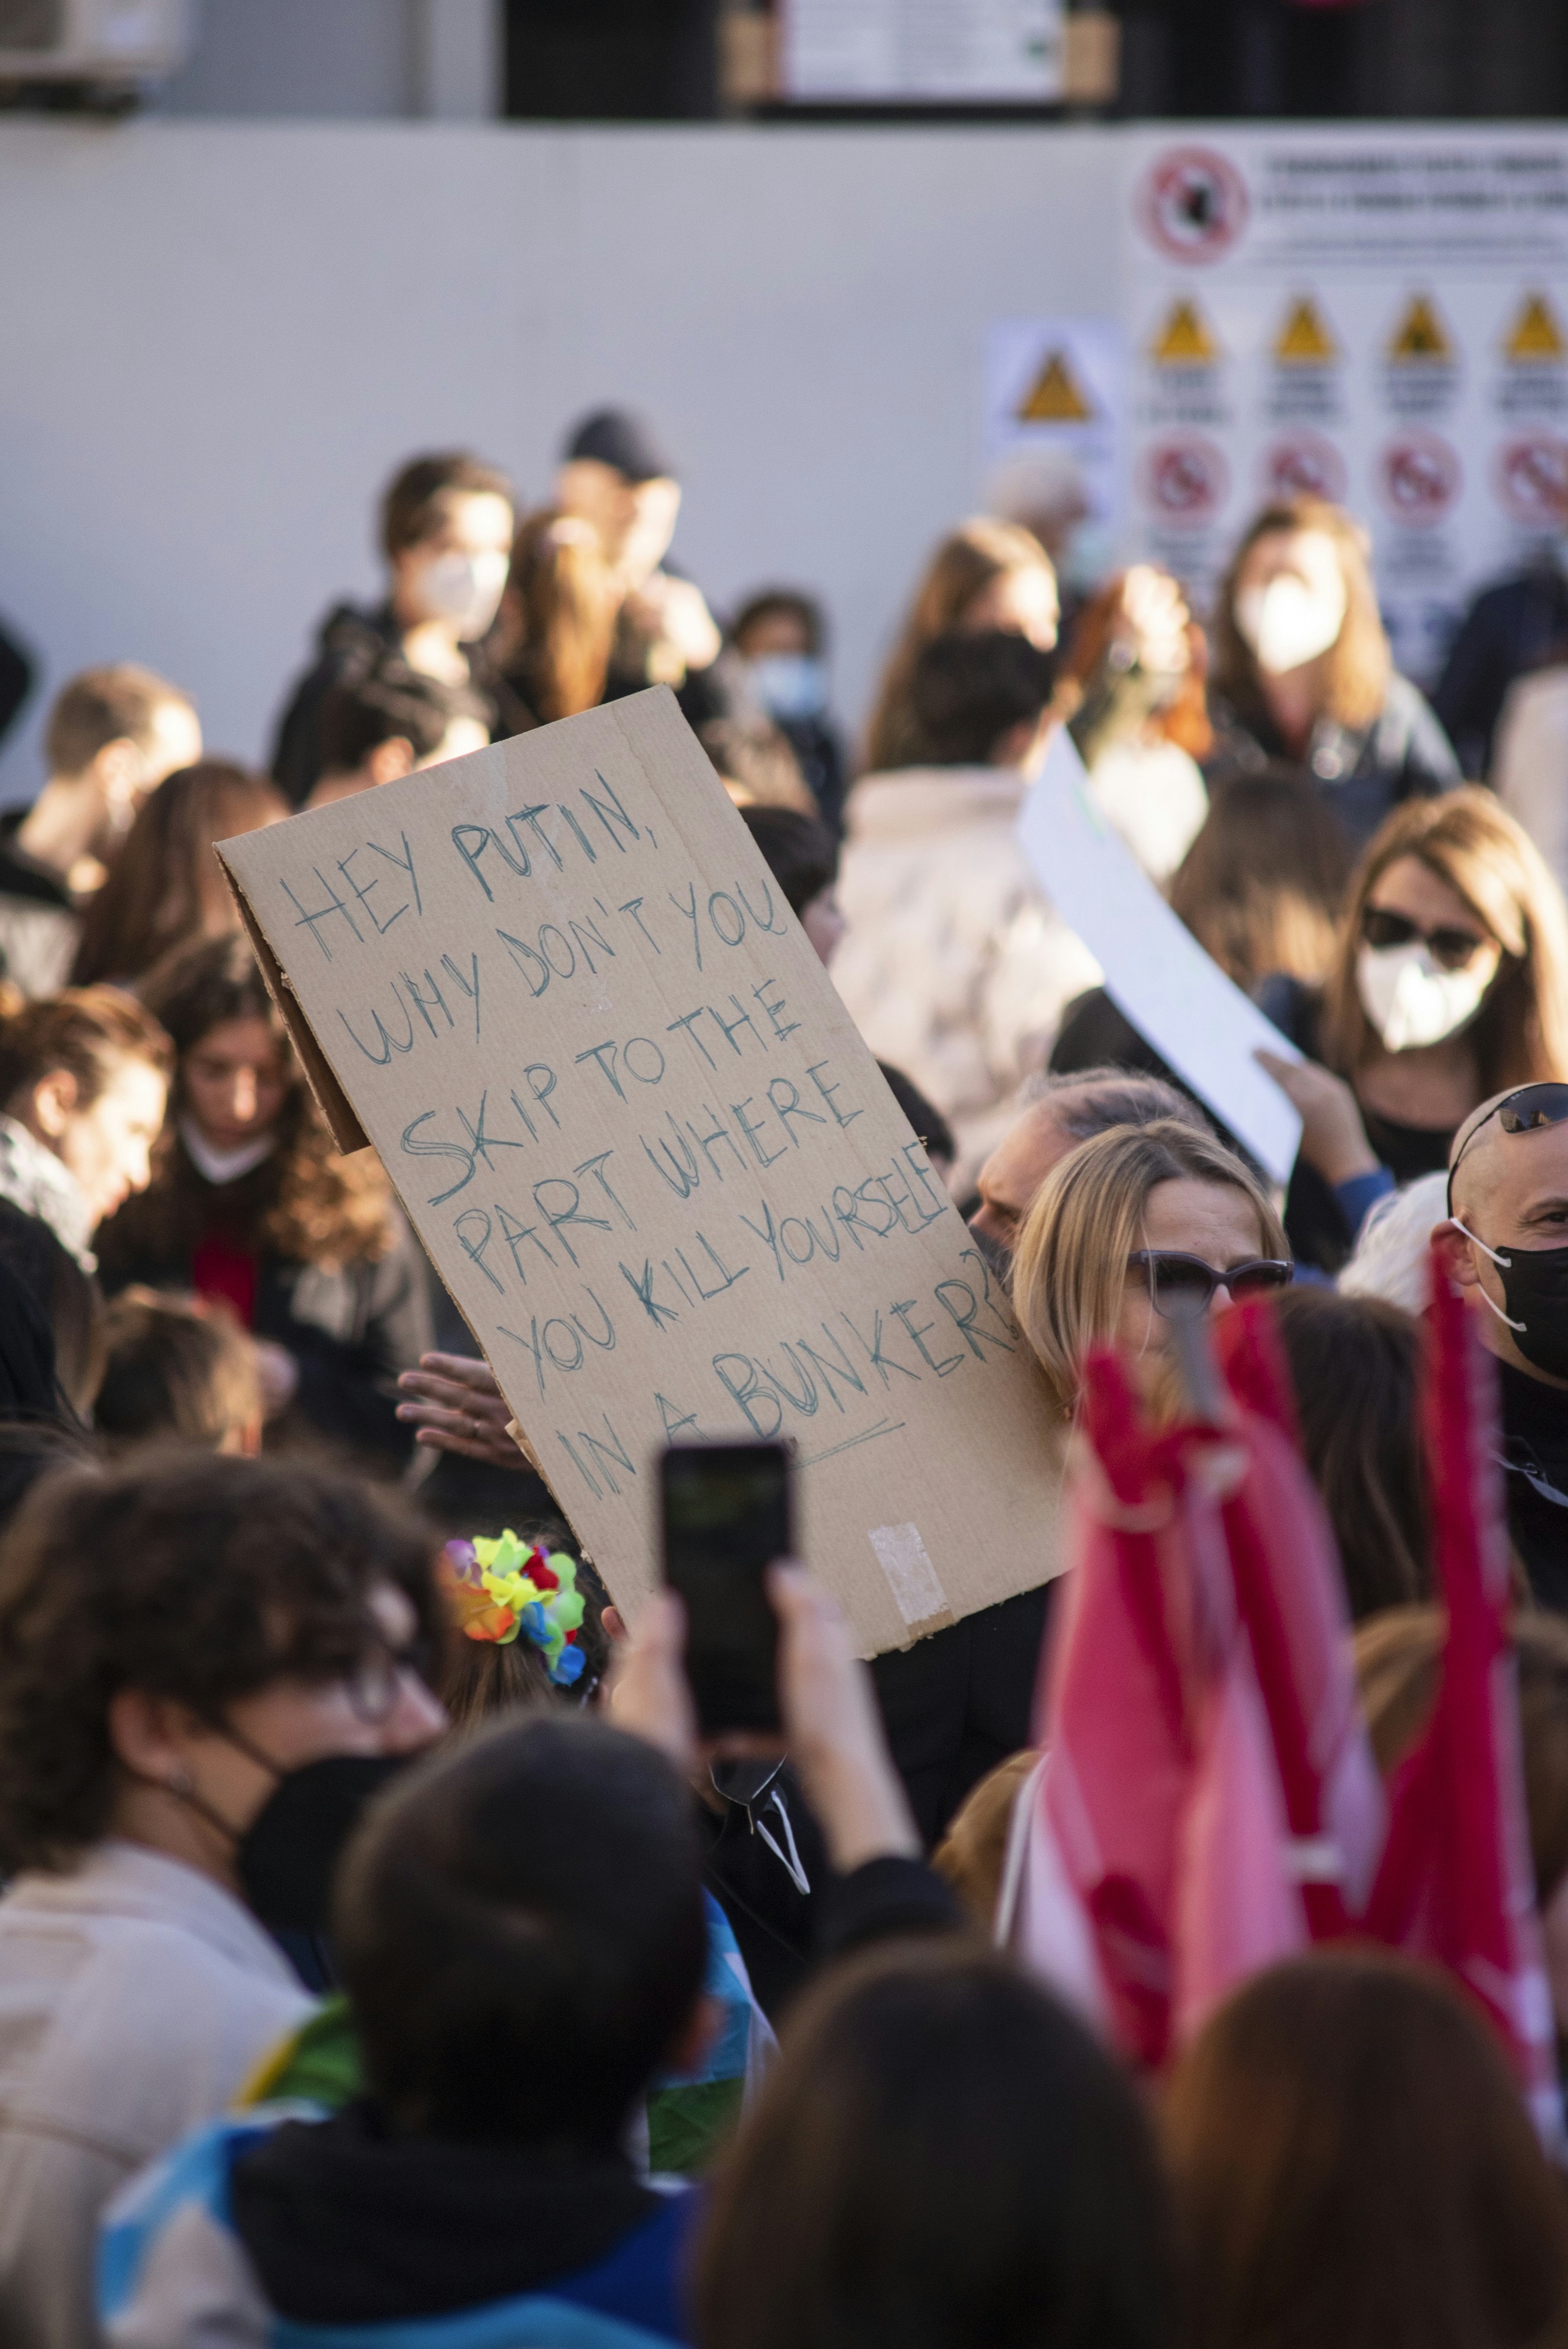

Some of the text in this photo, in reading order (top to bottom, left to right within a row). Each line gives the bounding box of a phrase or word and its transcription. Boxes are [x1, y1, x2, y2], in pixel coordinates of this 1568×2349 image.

[280, 769, 657, 963] HEY PUTIN,
[337, 879, 788, 1065] WHY DON'T YOU
[401, 979, 802, 1207] SKIP TO THE
[453, 1060, 864, 1295] PART WHERE
[496, 1142, 949, 1405] YOU KILL YOURSELF
[555, 1248, 1020, 1501] IN A BUNKER?
